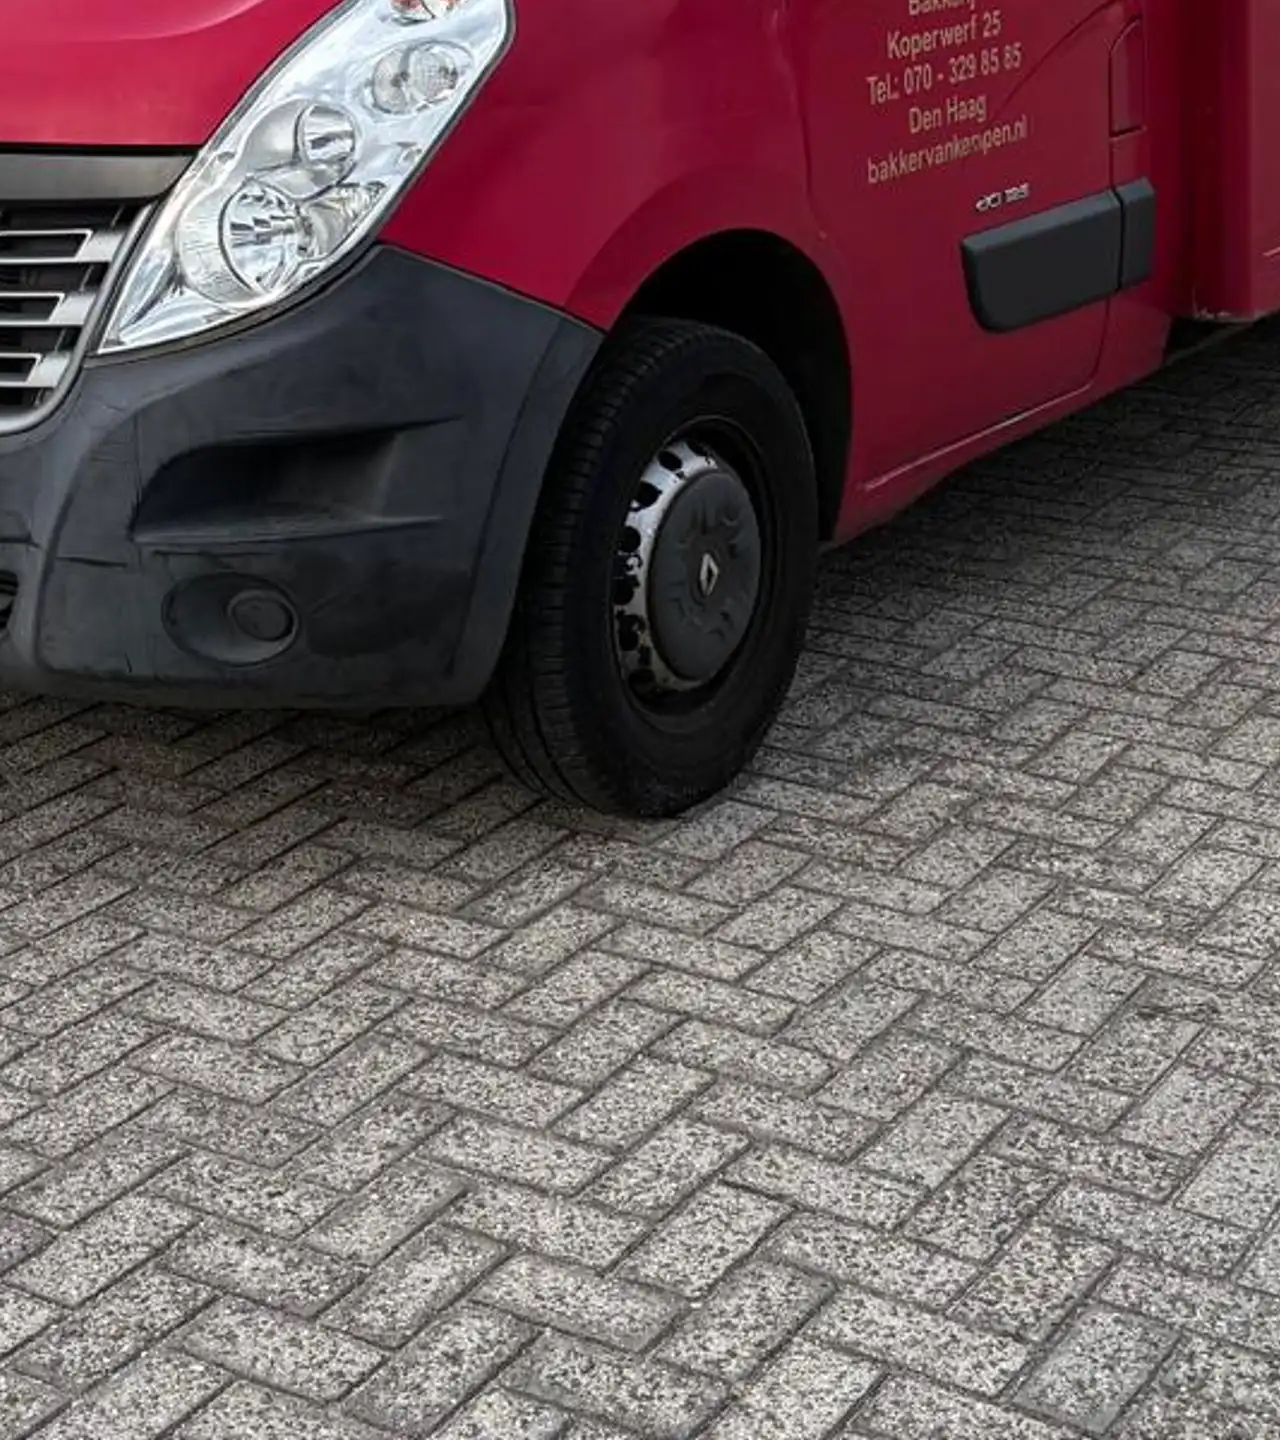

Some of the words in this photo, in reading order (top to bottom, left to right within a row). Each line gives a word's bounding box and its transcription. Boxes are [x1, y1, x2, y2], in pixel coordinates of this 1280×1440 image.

[886, 15, 978, 60] Koperwerf
[982, 10, 1002, 38] 25
[903, 63, 933, 96] 070
[948, 53, 977, 87] 329
[909, 104, 942, 135] Den
[946, 95, 987, 125] Haag
